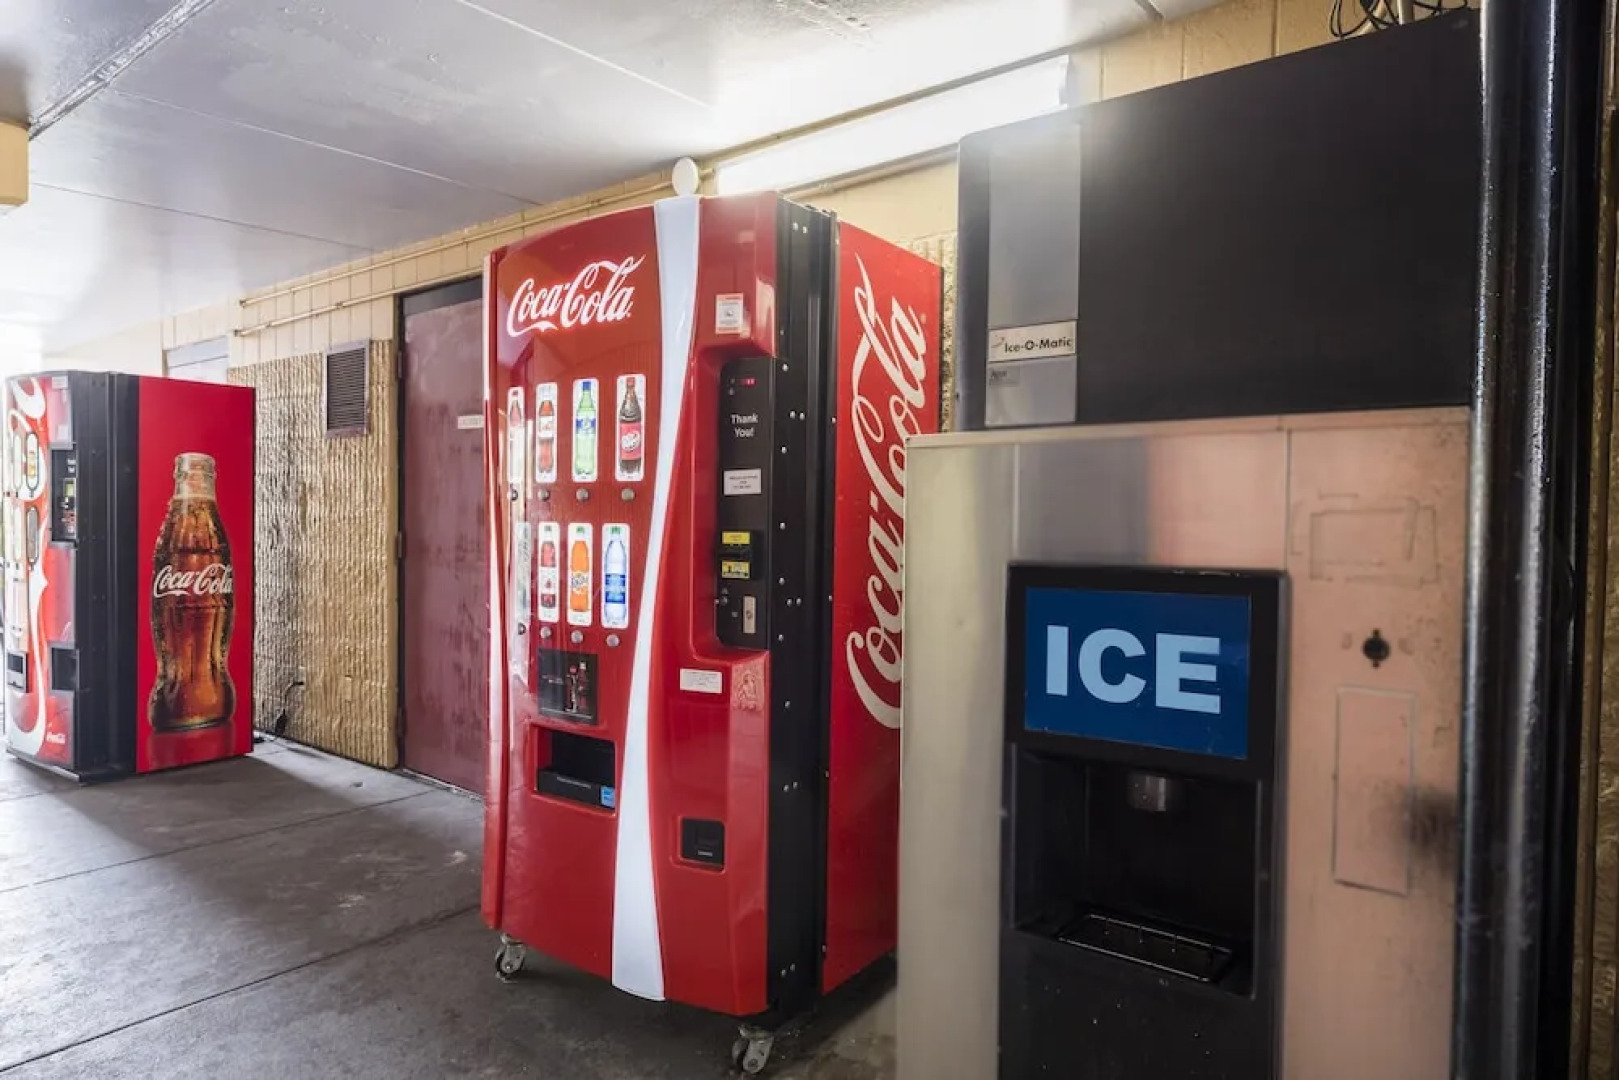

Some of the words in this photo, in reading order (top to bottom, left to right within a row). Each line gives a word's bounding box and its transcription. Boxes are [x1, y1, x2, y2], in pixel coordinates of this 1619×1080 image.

[506, 254, 646, 337] Coca-Cola
[1004, 336, 1073, 353] Ice-O-Matic
[731, 412, 759, 424] Thank
[734, 427, 755, 438] You!
[153, 563, 233, 598] Coca-Cola
[1046, 625, 1221, 714] ICE
